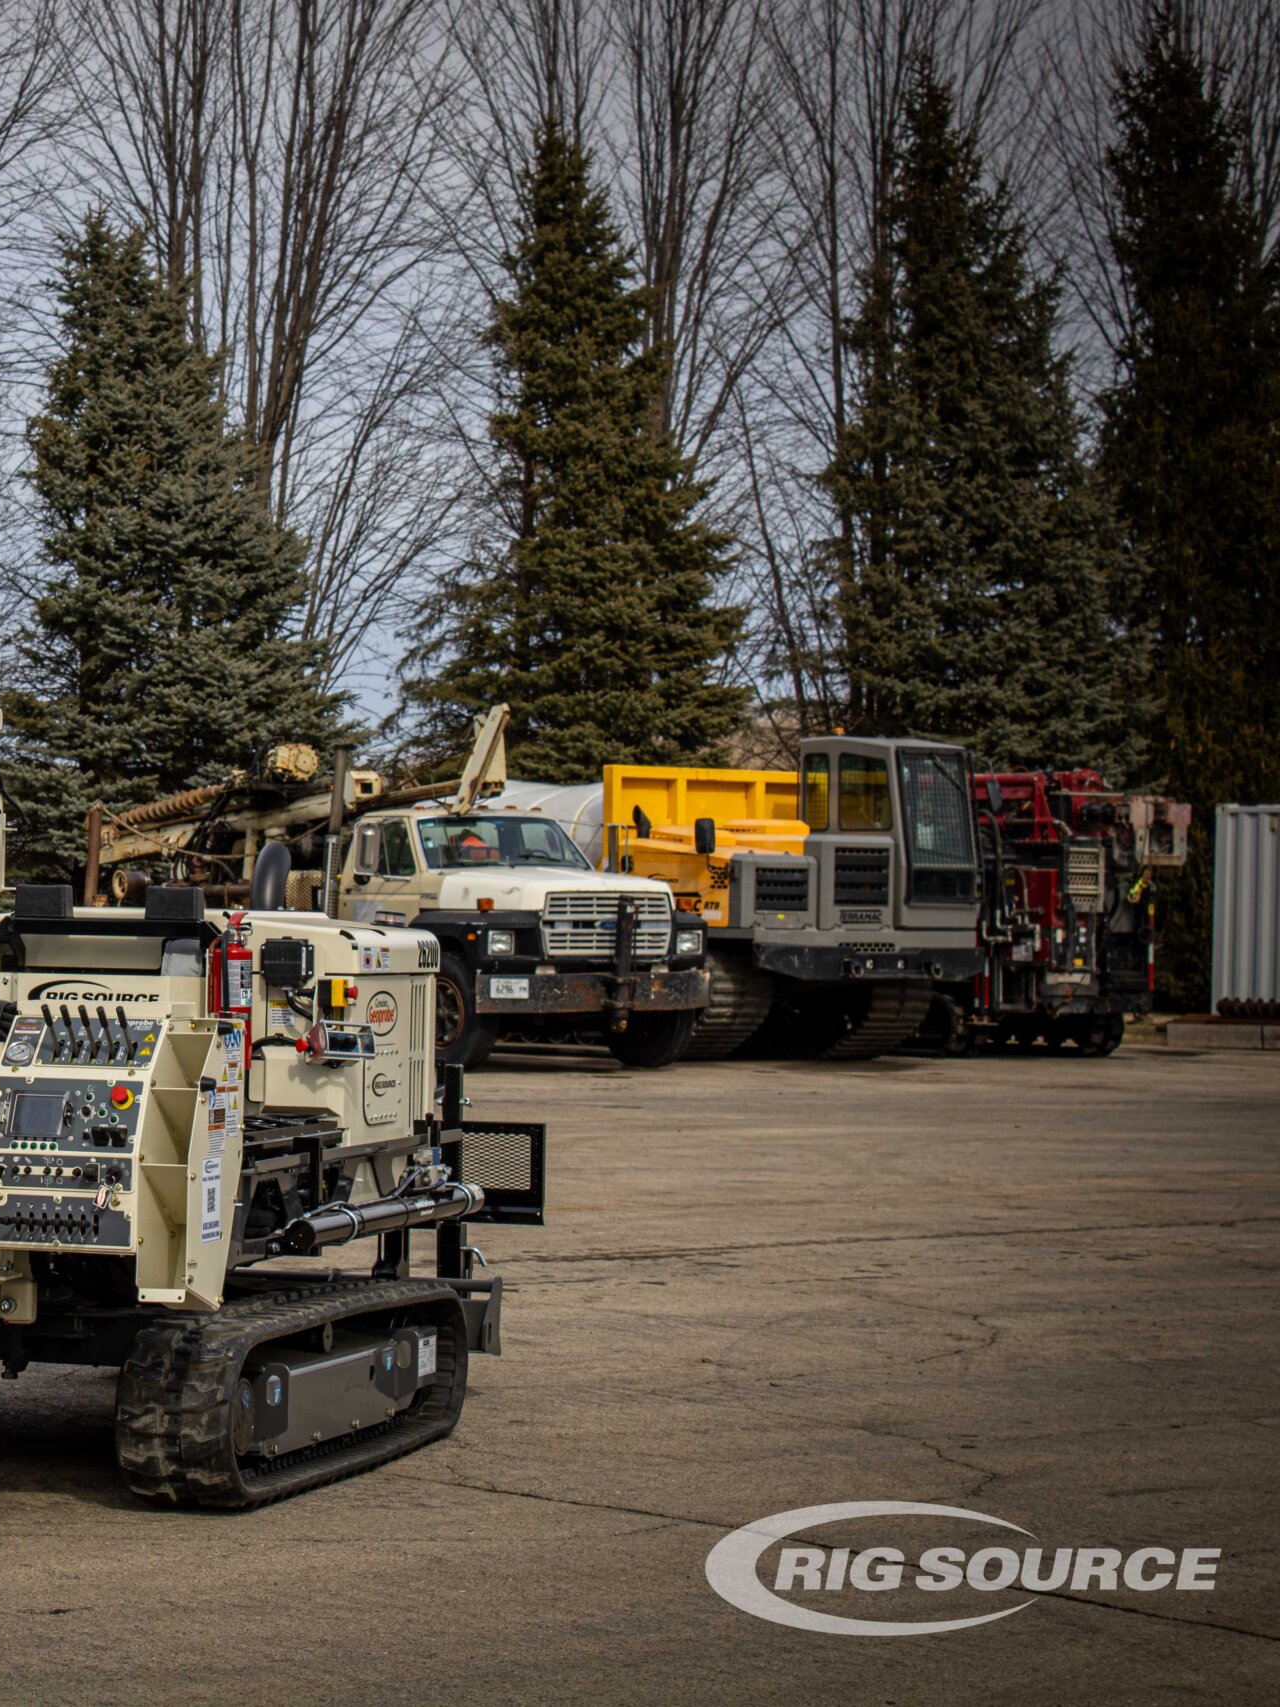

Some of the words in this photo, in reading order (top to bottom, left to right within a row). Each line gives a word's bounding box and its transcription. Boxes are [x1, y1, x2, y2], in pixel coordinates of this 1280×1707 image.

[416, 940, 439, 968] 26200
[81, 993, 159, 1002] SOURCE
[370, 1007, 394, 1028] Geoprobe
